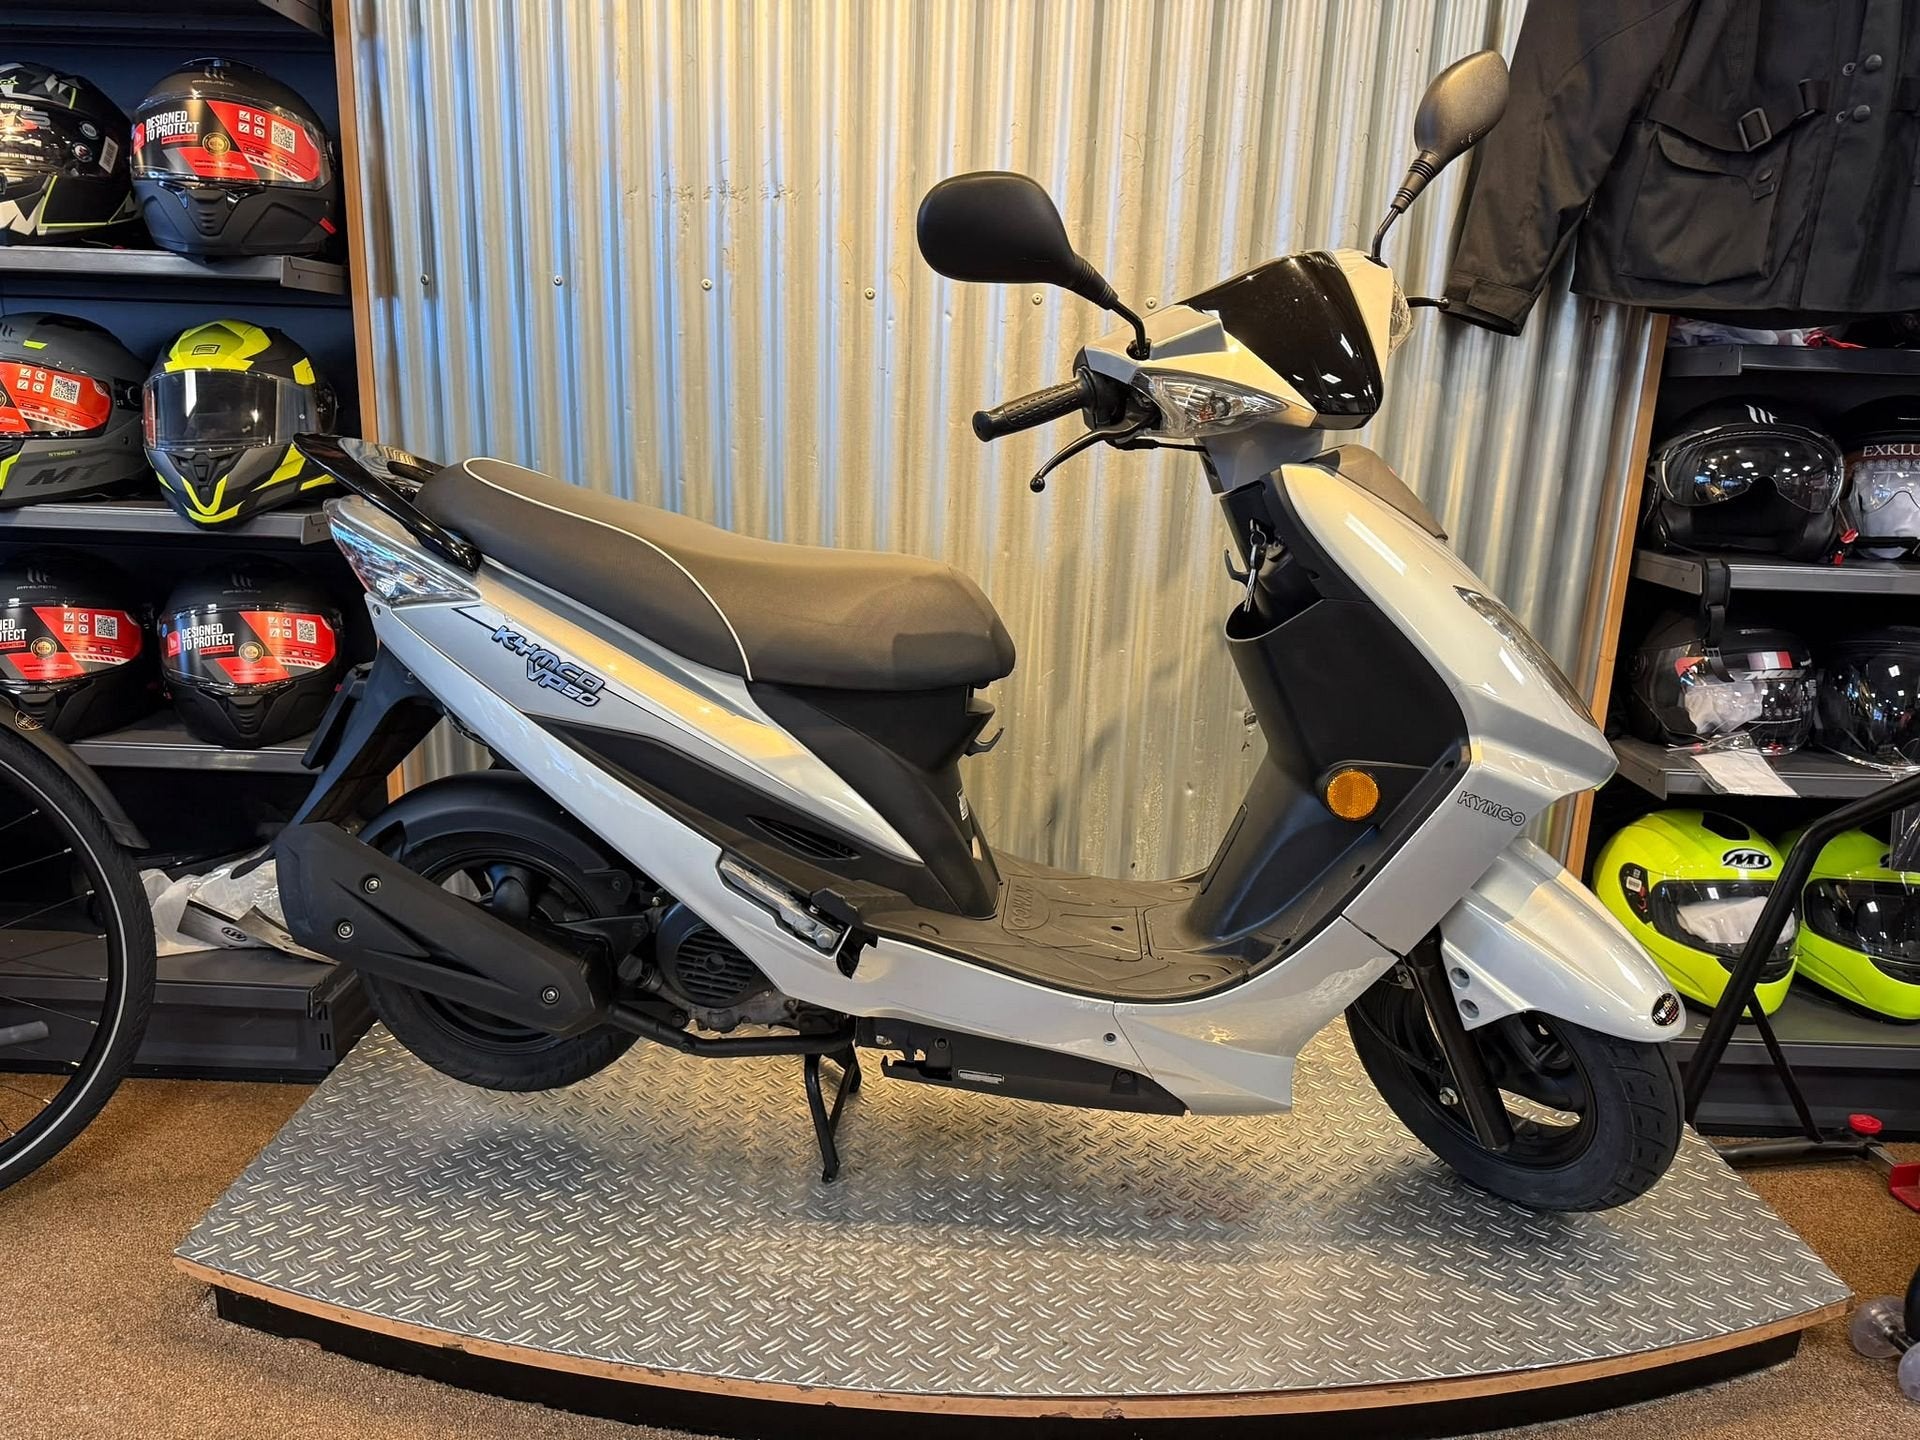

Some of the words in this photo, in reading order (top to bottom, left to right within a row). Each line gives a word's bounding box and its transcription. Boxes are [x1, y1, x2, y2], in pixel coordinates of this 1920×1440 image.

[146, 110, 188, 131] DESIGNED
[146, 129, 155, 143] TO
[156, 121, 199, 139] PROTECT
[1862, 444, 1920, 457] EXKLU
[181, 623, 223, 640] DESIGNED
[182, 639, 193, 651] TO
[193, 633, 235, 649] PROTECT
[491, 625, 605, 694] KYMCO
[526, 658, 600, 707] VP50
[1457, 790, 1526, 826] KYMCO
[1010, 885, 1032, 928] KYMCO
